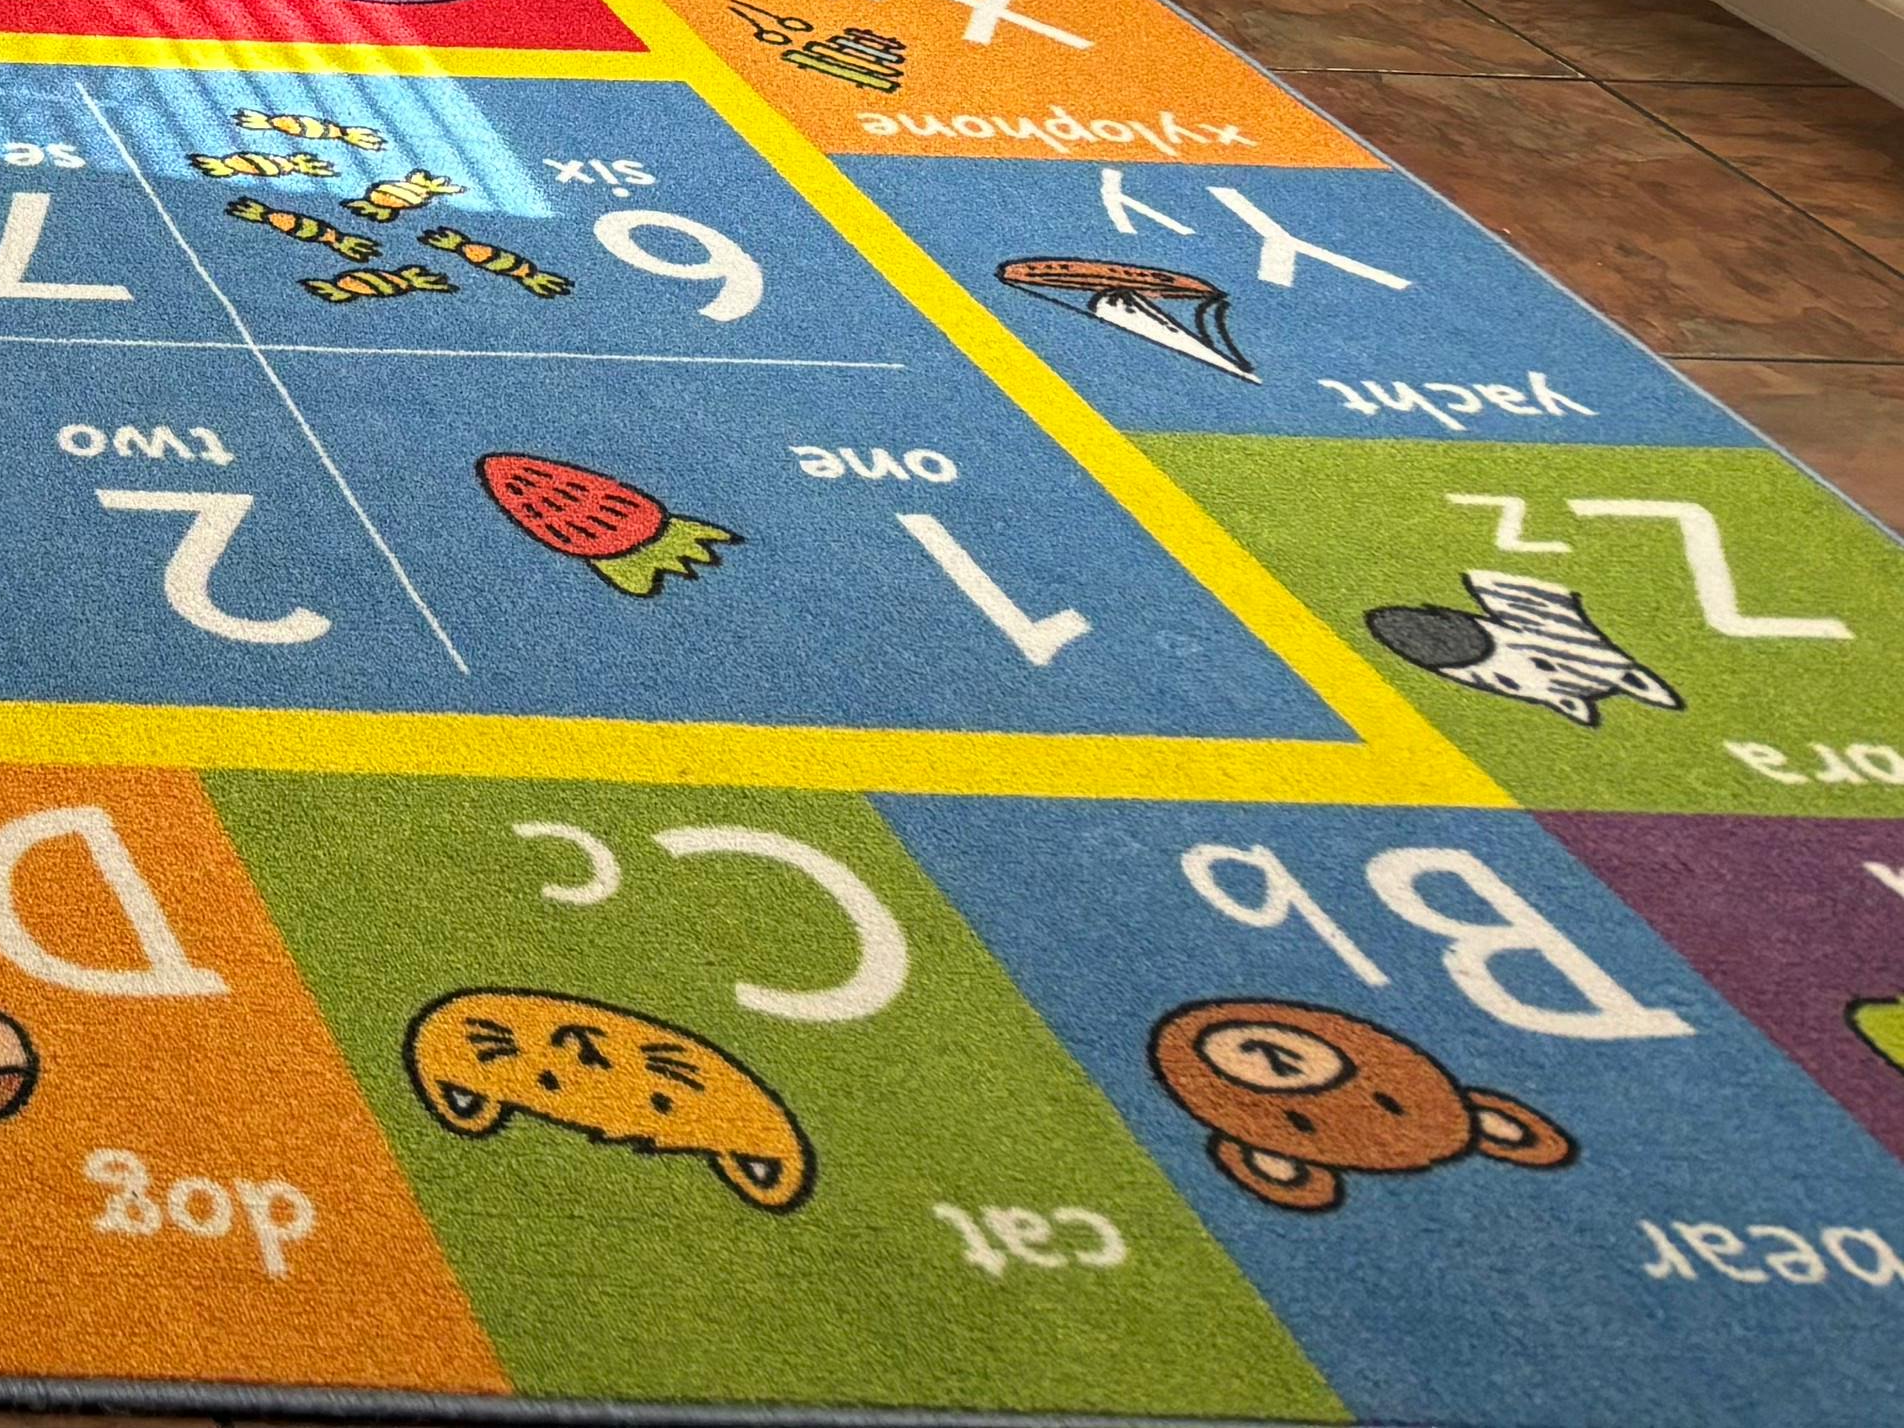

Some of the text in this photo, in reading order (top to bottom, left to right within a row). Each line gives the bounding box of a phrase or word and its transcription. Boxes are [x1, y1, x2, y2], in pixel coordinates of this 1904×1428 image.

[860, 104, 1260, 156] xylophone
[543, 159, 655, 201] six
[594, 210, 763, 322] 6
[1319, 372, 1595, 431] yacht
[57, 424, 234, 465] two
[790, 446, 958, 483] one
[95, 489, 331, 645] 2
[896, 513, 1091, 666] 1
[83, 1149, 316, 1278] dog
[933, 1203, 1127, 1276] cat
